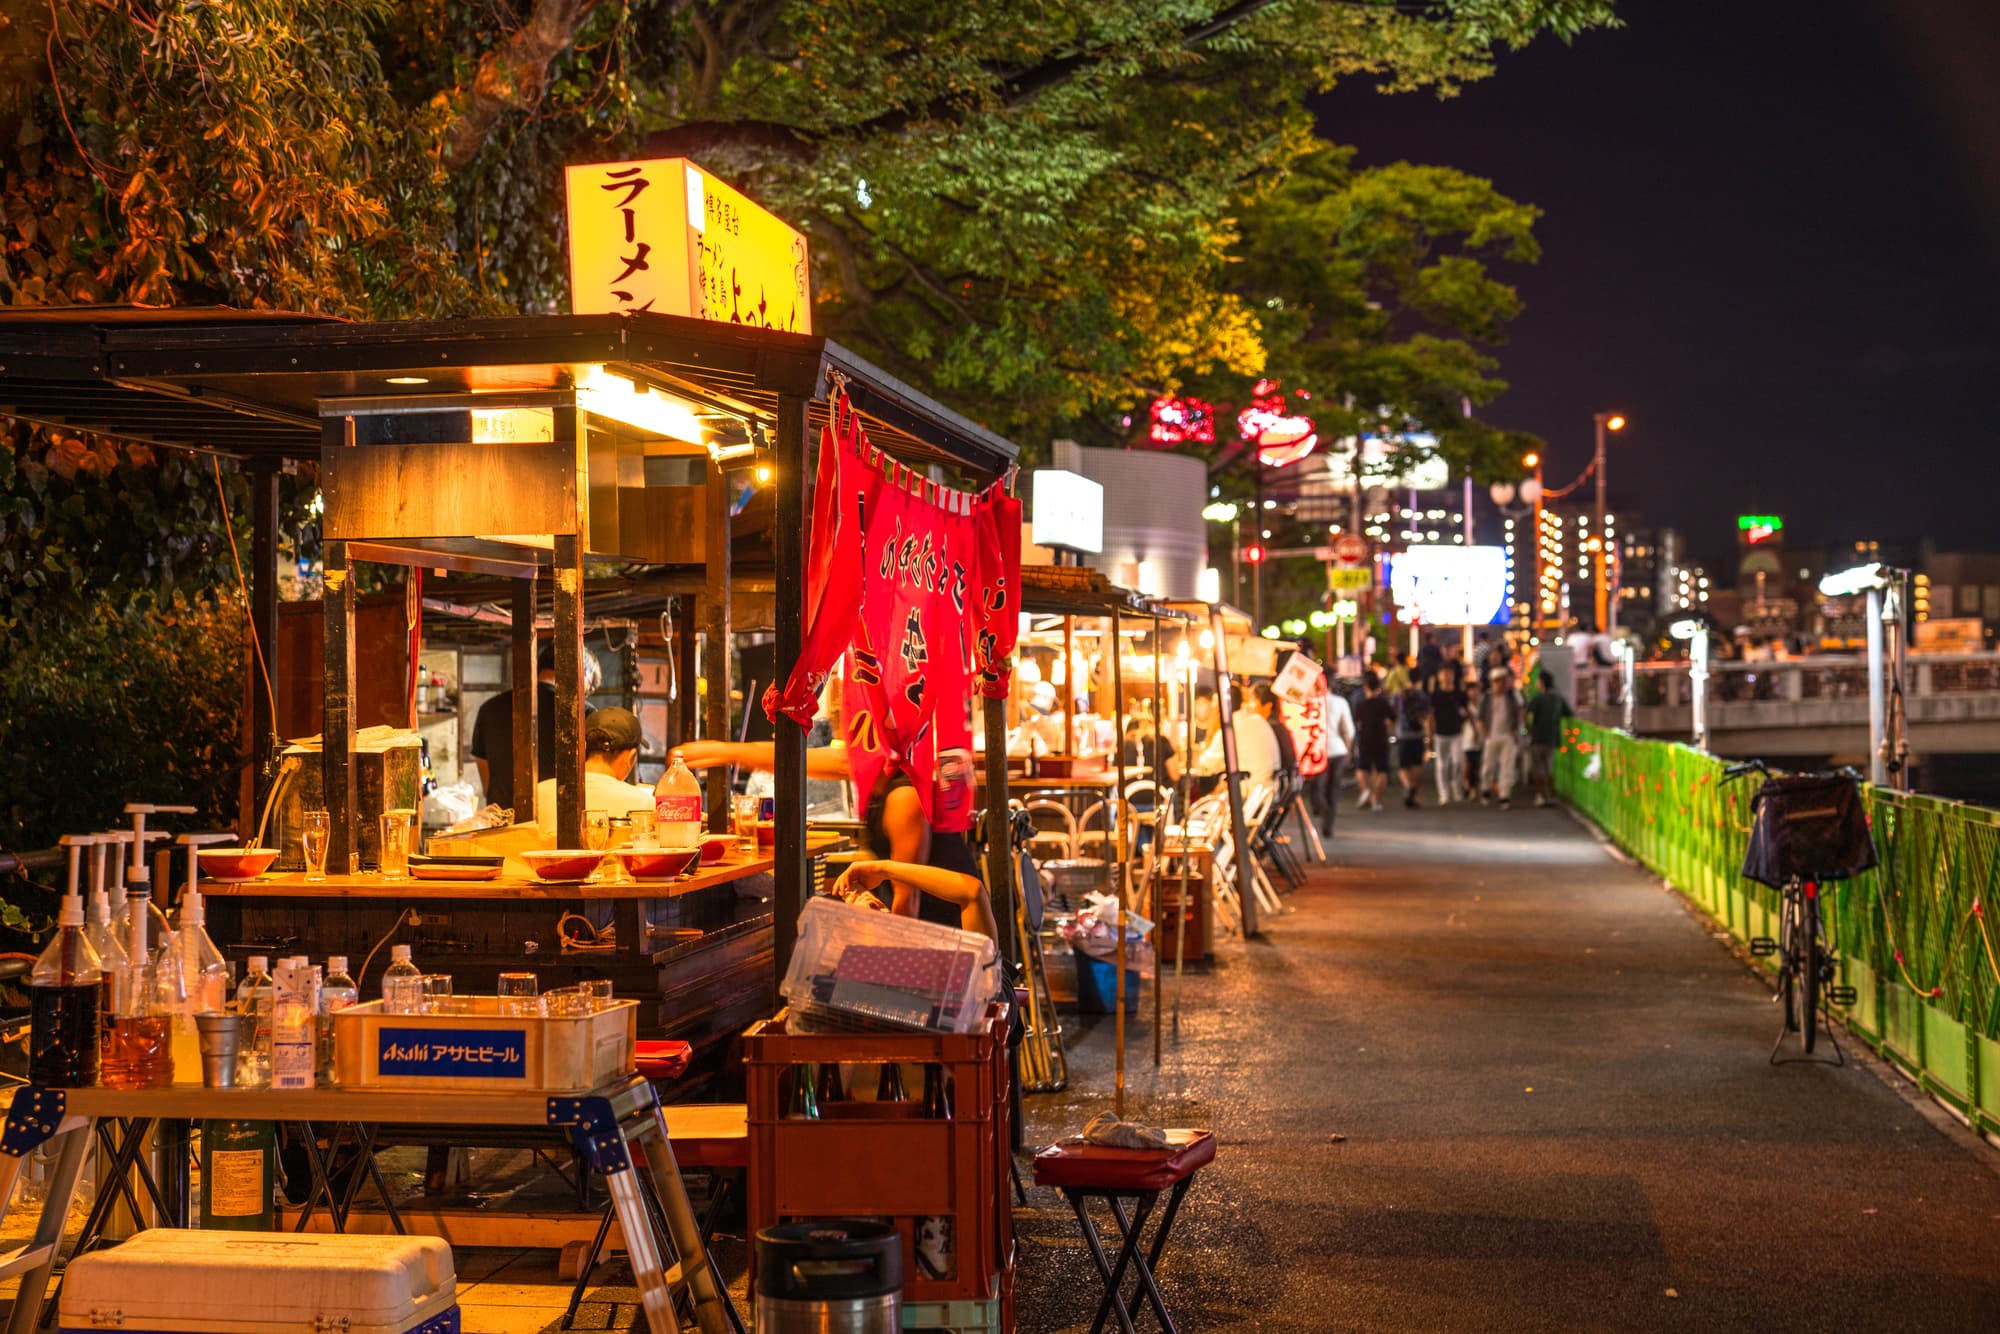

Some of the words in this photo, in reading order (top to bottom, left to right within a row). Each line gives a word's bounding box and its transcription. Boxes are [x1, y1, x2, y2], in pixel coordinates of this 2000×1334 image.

[697, 233, 725, 270] ラーメン
[1299, 698, 1325, 765] おでん
[383, 1042, 429, 1061] Asahi
[432, 1045, 521, 1063] アサヒビール
